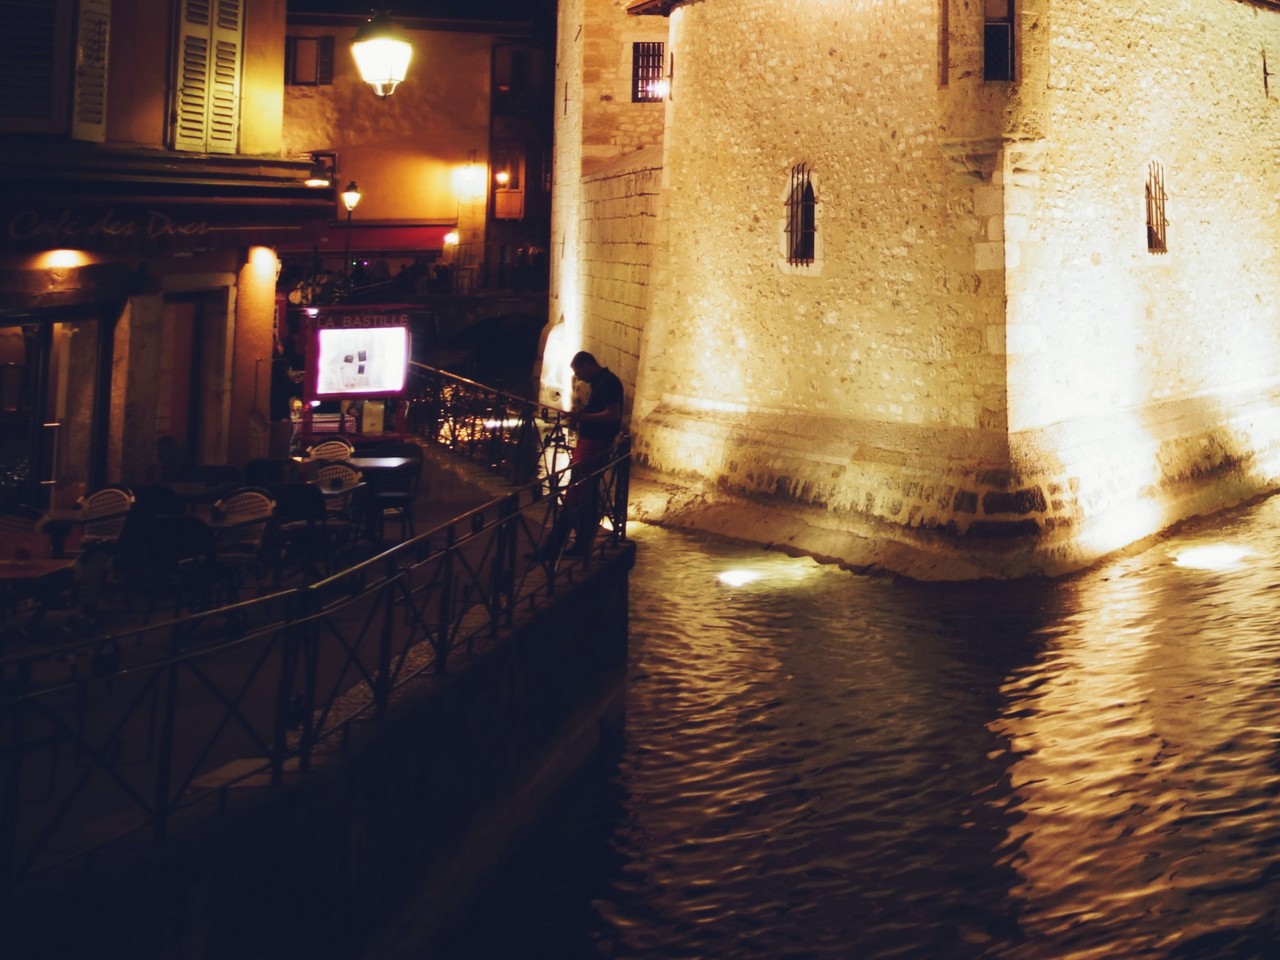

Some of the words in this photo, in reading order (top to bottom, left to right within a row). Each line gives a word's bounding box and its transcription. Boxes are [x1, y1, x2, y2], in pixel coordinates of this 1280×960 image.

[8, 209, 82, 243] Café
[84, 208, 135, 236] des
[317, 315, 335, 328] LA
[343, 314, 409, 328] BASTILLE
